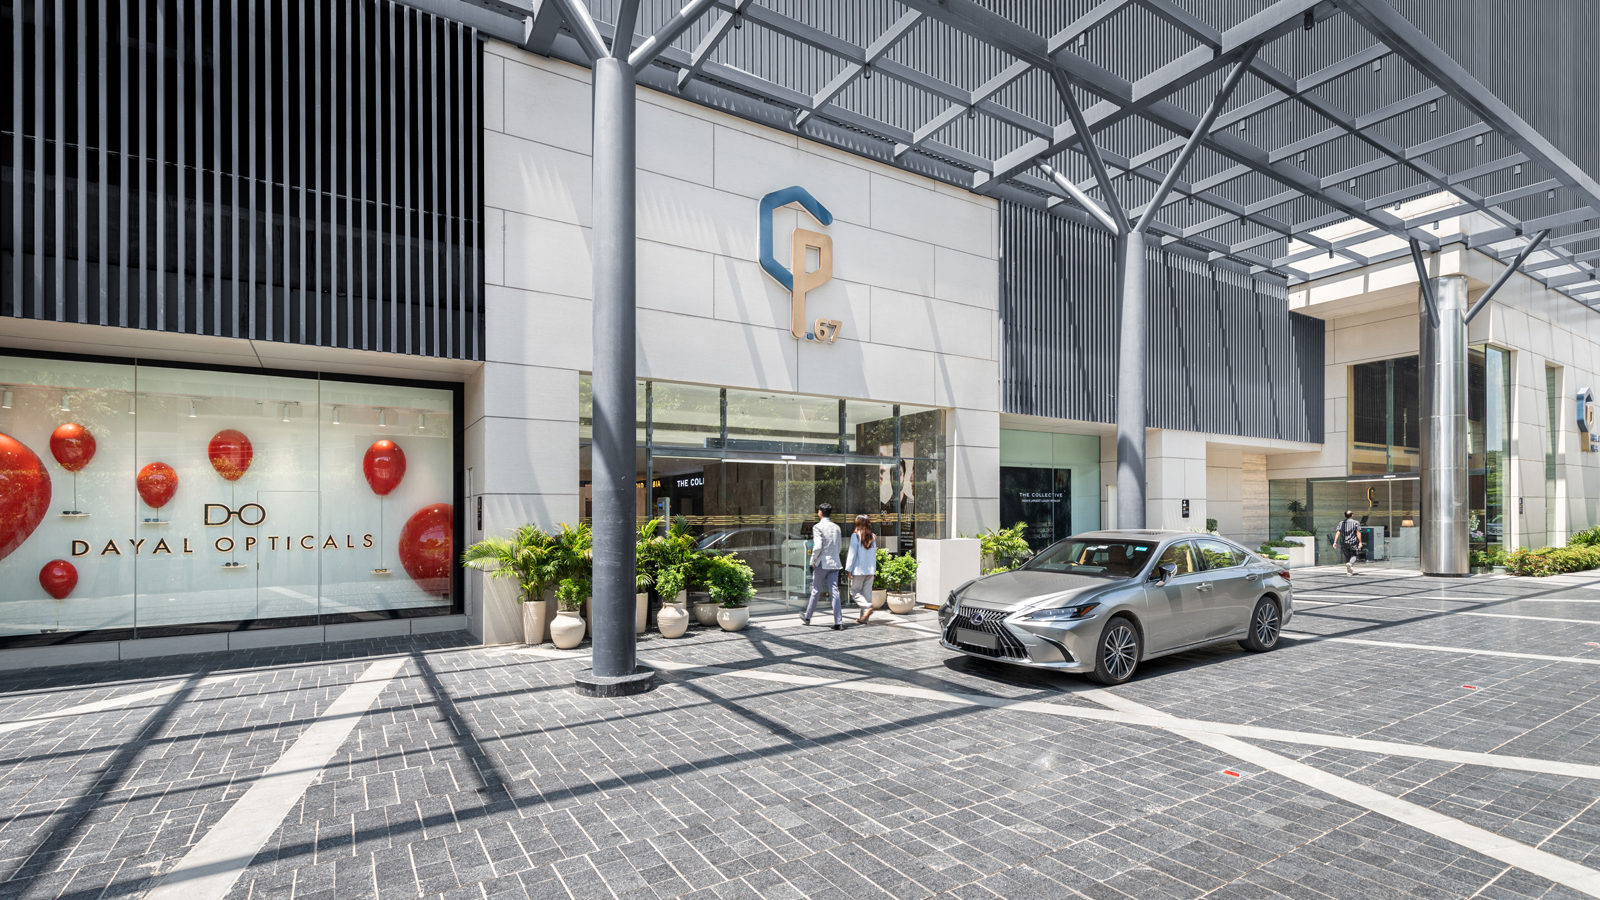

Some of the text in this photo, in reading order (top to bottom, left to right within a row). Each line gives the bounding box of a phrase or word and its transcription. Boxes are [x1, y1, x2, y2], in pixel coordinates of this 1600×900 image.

[677, 479, 689, 488] THE
[71, 533, 374, 557] DAYAL OPTICALS
